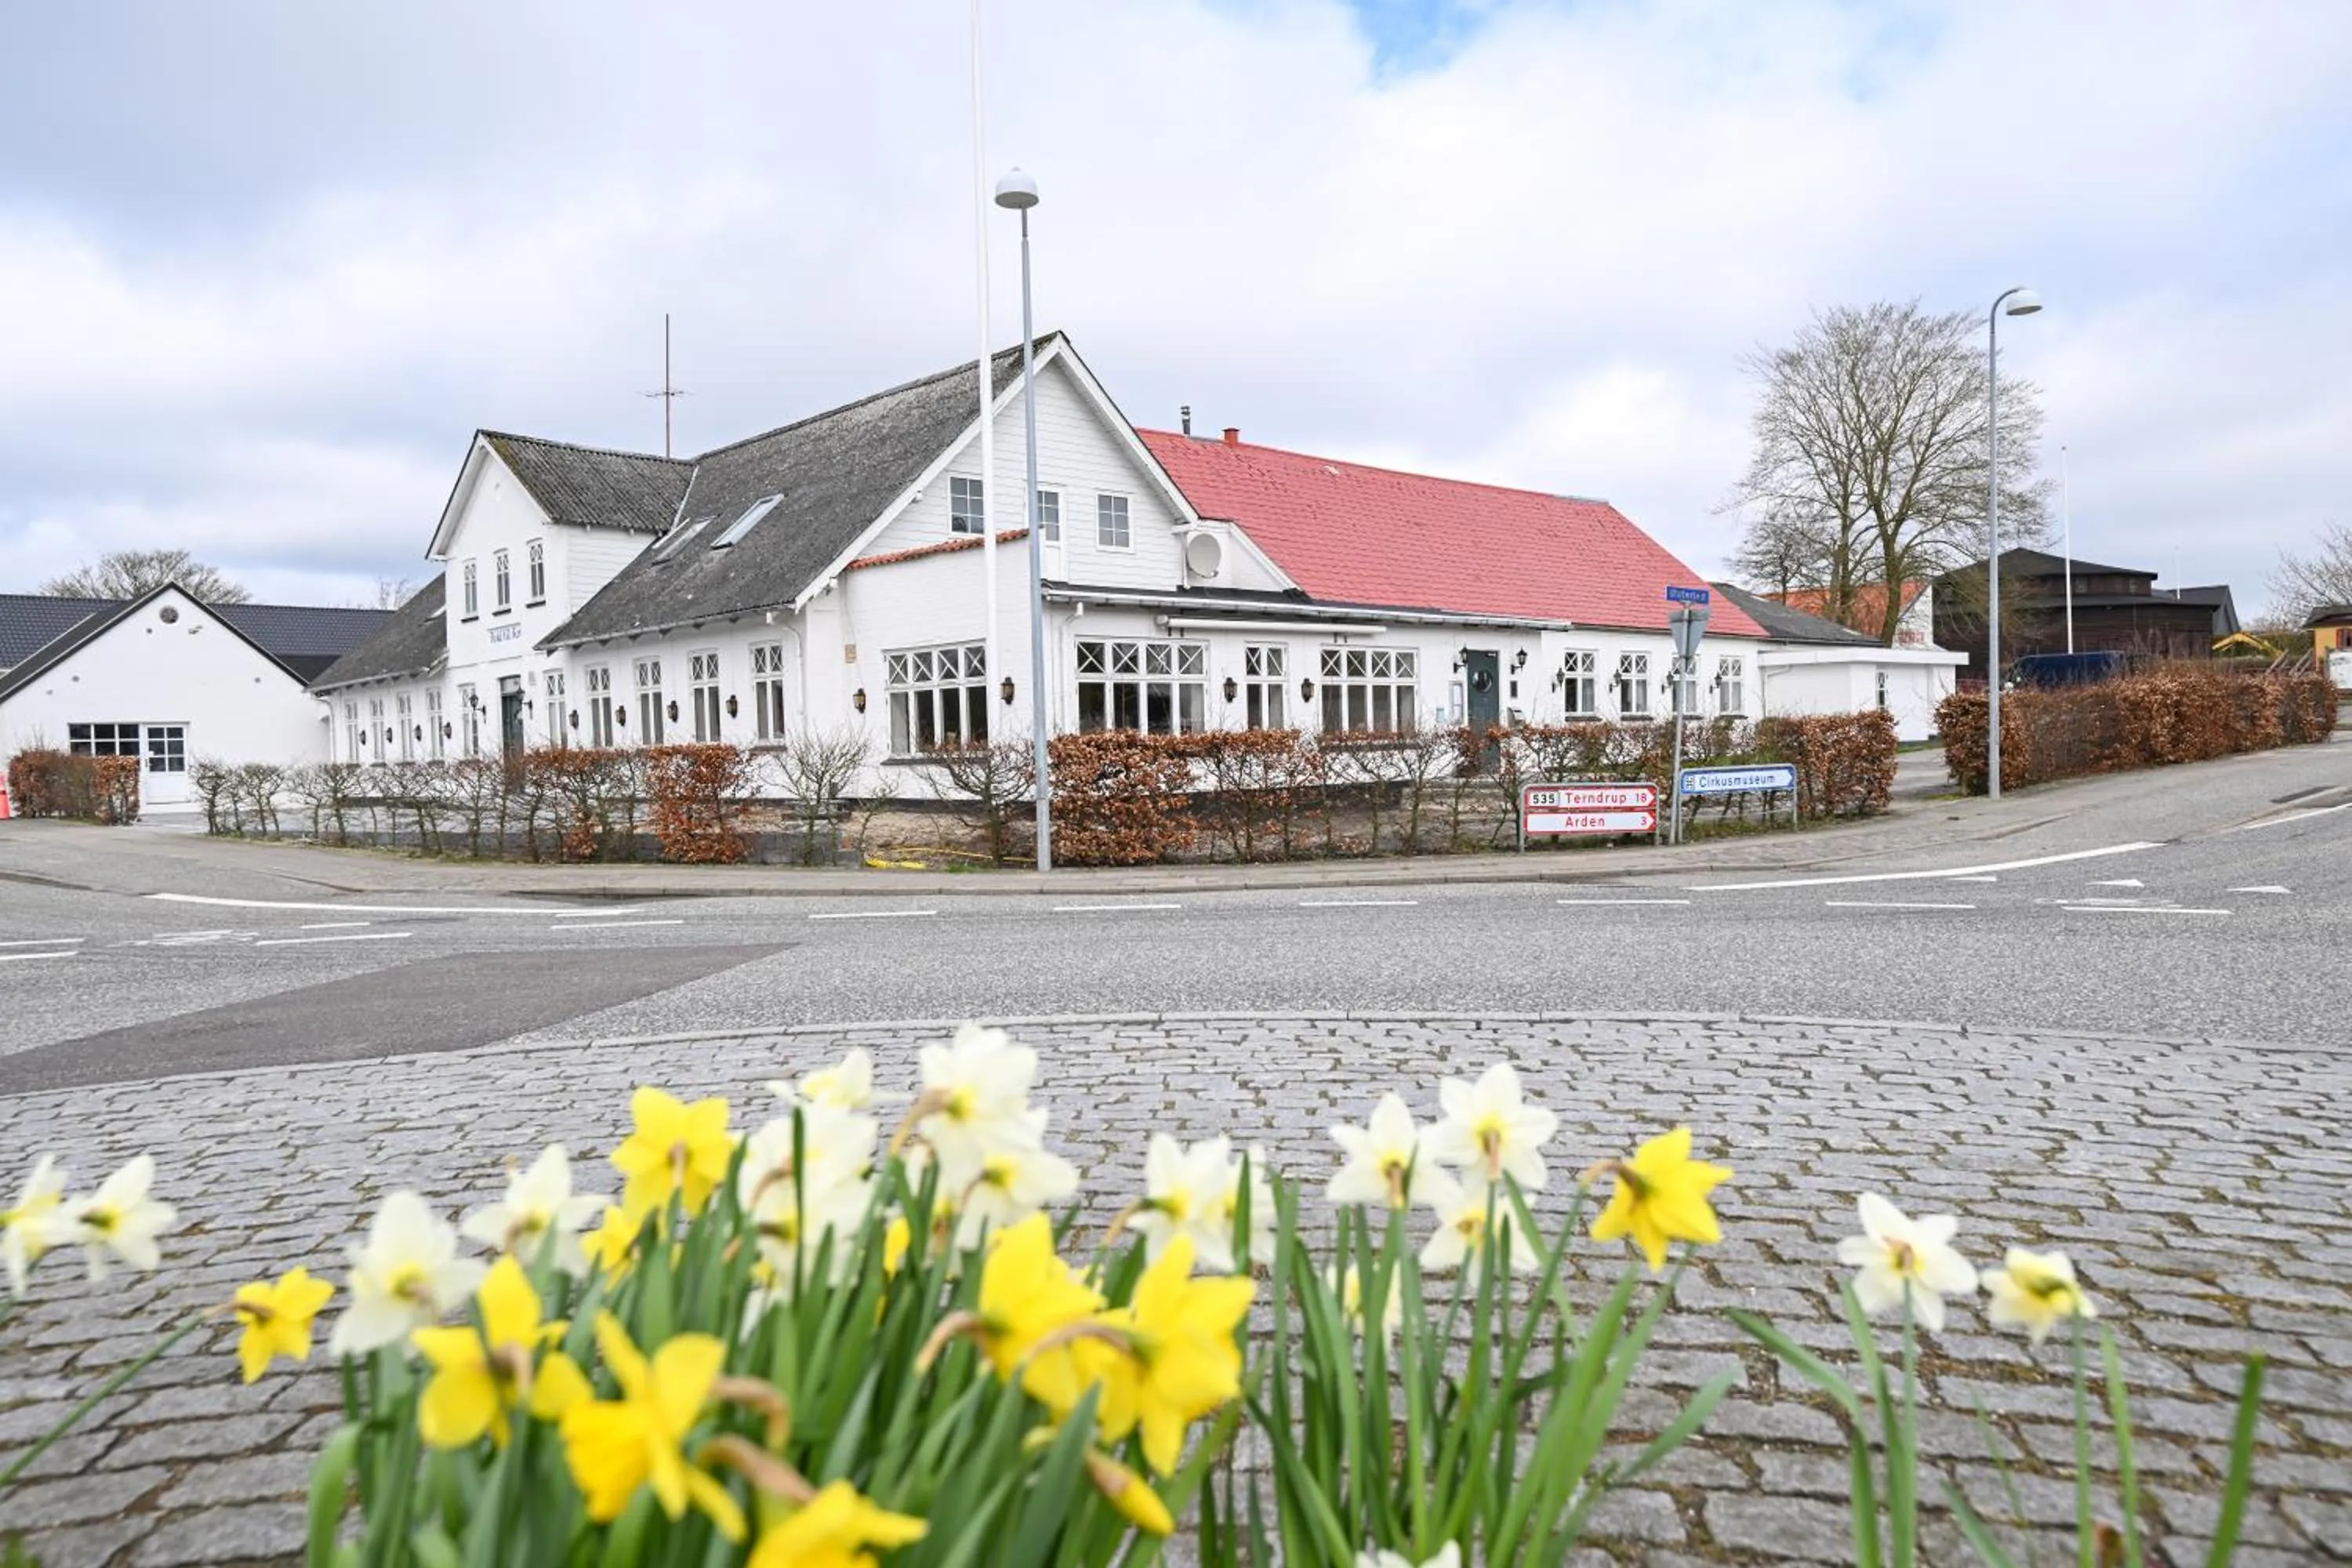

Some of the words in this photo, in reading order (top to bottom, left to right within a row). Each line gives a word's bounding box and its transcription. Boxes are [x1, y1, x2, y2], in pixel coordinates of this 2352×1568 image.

[1699, 775, 1775, 788] Cirkusmuseum
[1533, 793, 1555, 804] 535
[1566, 792, 1627, 804] Terndrup
[1635, 793, 1647, 803] 18
[1565, 815, 1605, 827] Arden
[1640, 816, 1647, 826] 3
